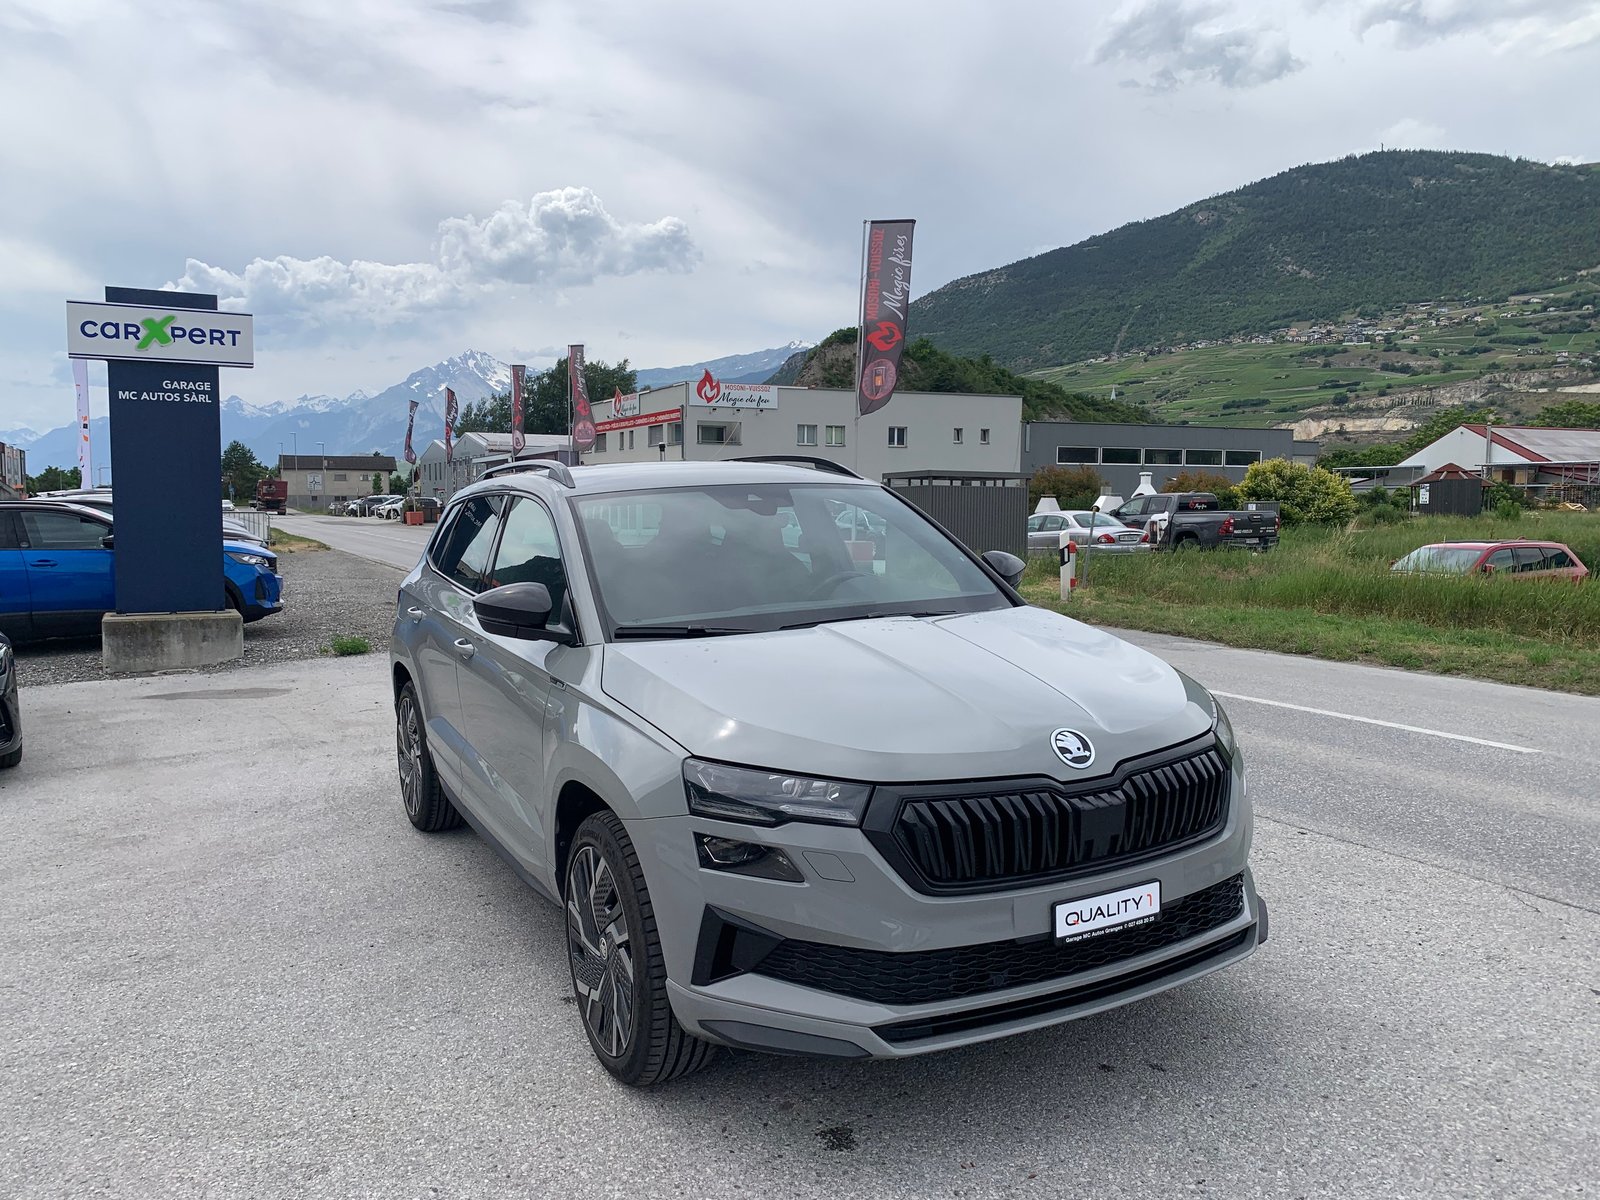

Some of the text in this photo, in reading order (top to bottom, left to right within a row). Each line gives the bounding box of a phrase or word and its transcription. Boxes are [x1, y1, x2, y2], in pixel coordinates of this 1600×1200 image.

[882, 234, 912, 320] Magic fires
[162, 380, 211, 391] GARAGE
[118, 391, 138, 400] MC
[141, 392, 181, 402] AUTOS
[715, 391, 770, 407] Magie du feu
[1065, 893, 1153, 926] QUALITY 1
[1065, 935, 1082, 943] Garage
[1104, 925, 1123, 933] Granges
